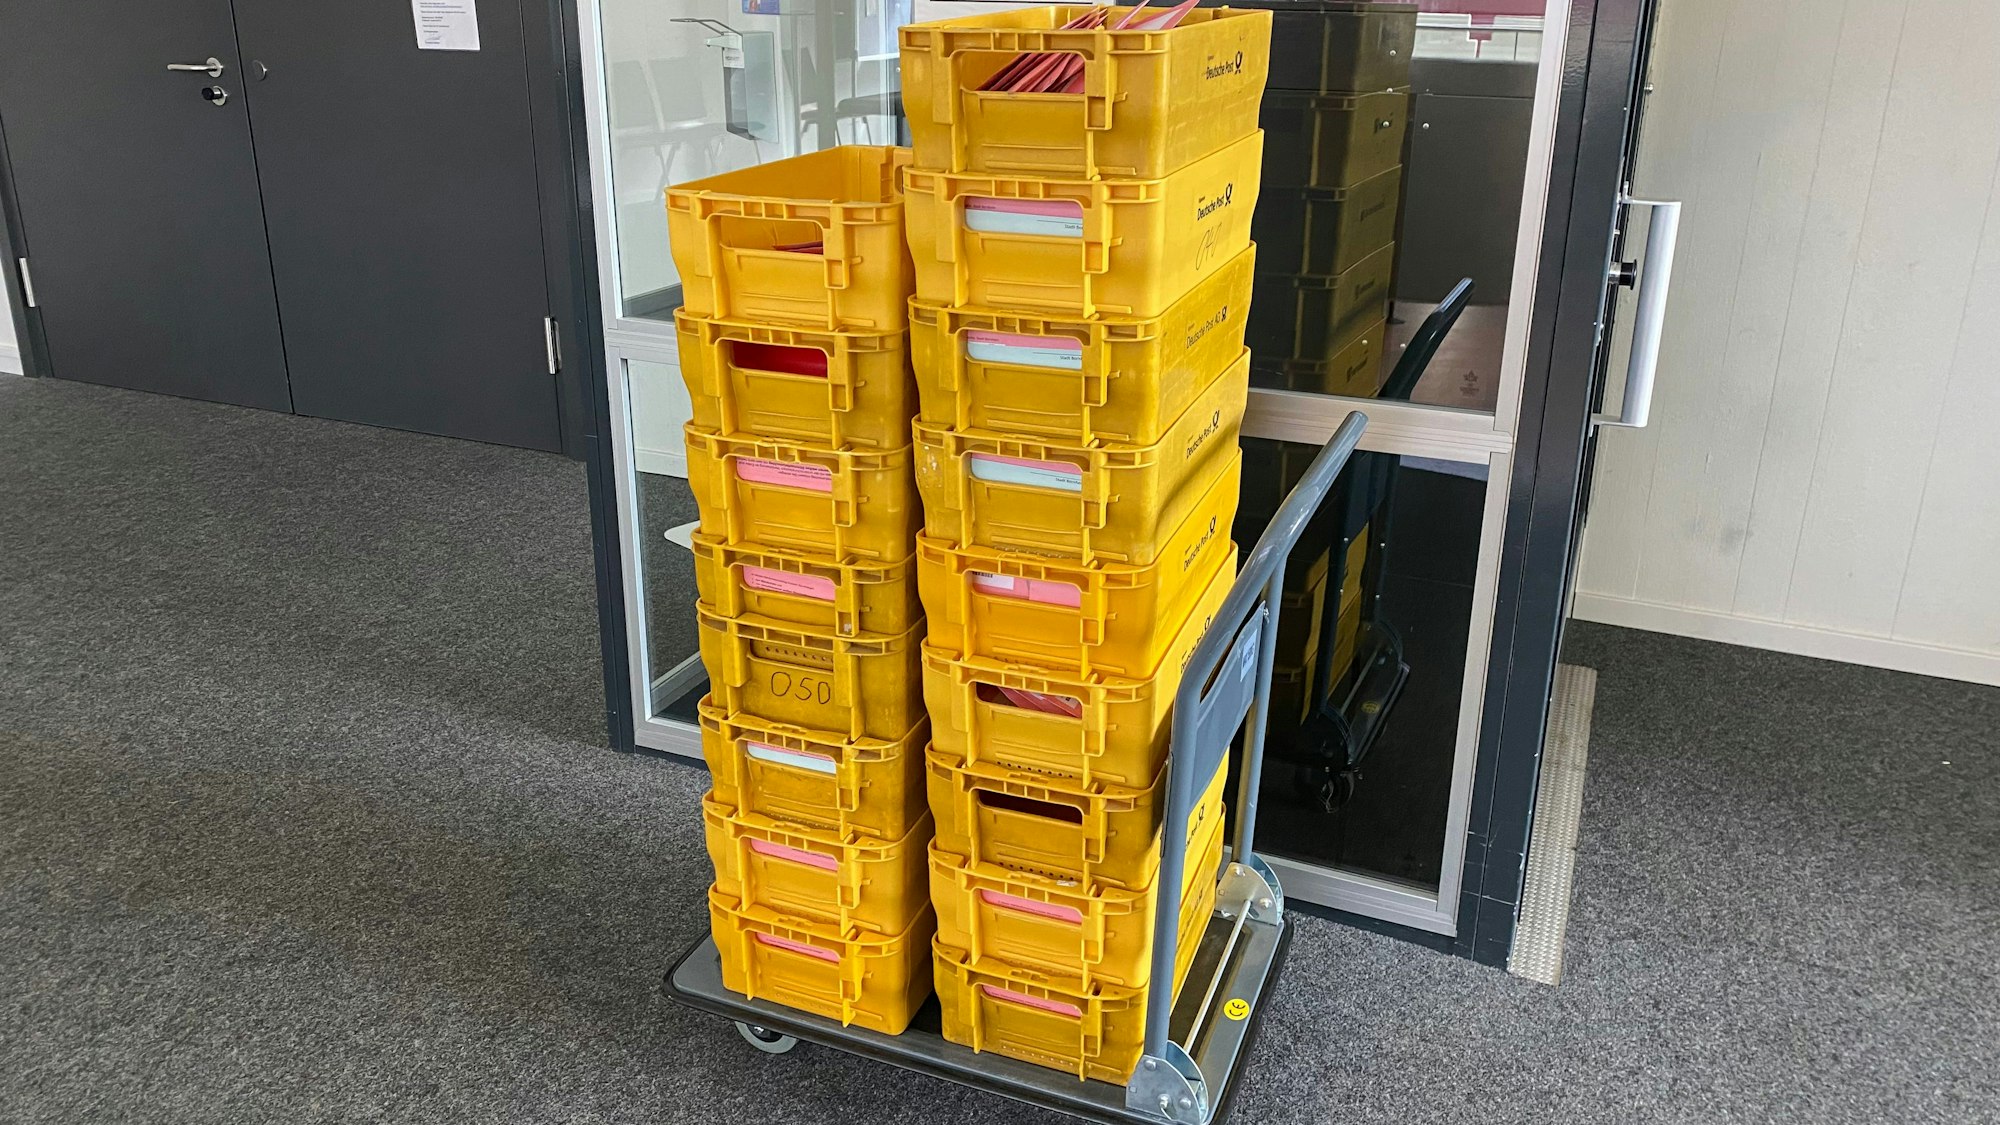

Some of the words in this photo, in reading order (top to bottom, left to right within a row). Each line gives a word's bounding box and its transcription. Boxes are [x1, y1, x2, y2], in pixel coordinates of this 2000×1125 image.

[1206, 62, 1225, 80] Deutsche
[1225, 60, 1234, 75] Post
[1197, 201, 1216, 221] Deutsche
[1216, 194, 1225, 210] Post
[1186, 326, 1206, 349] Deutsche
[1206, 319, 1214, 332] Post
[1186, 432, 1204, 459] Deutsche
[1203, 425, 1212, 440] Post
[1184, 543, 1201, 572] Deutsche
[1200, 532, 1209, 548] Post
